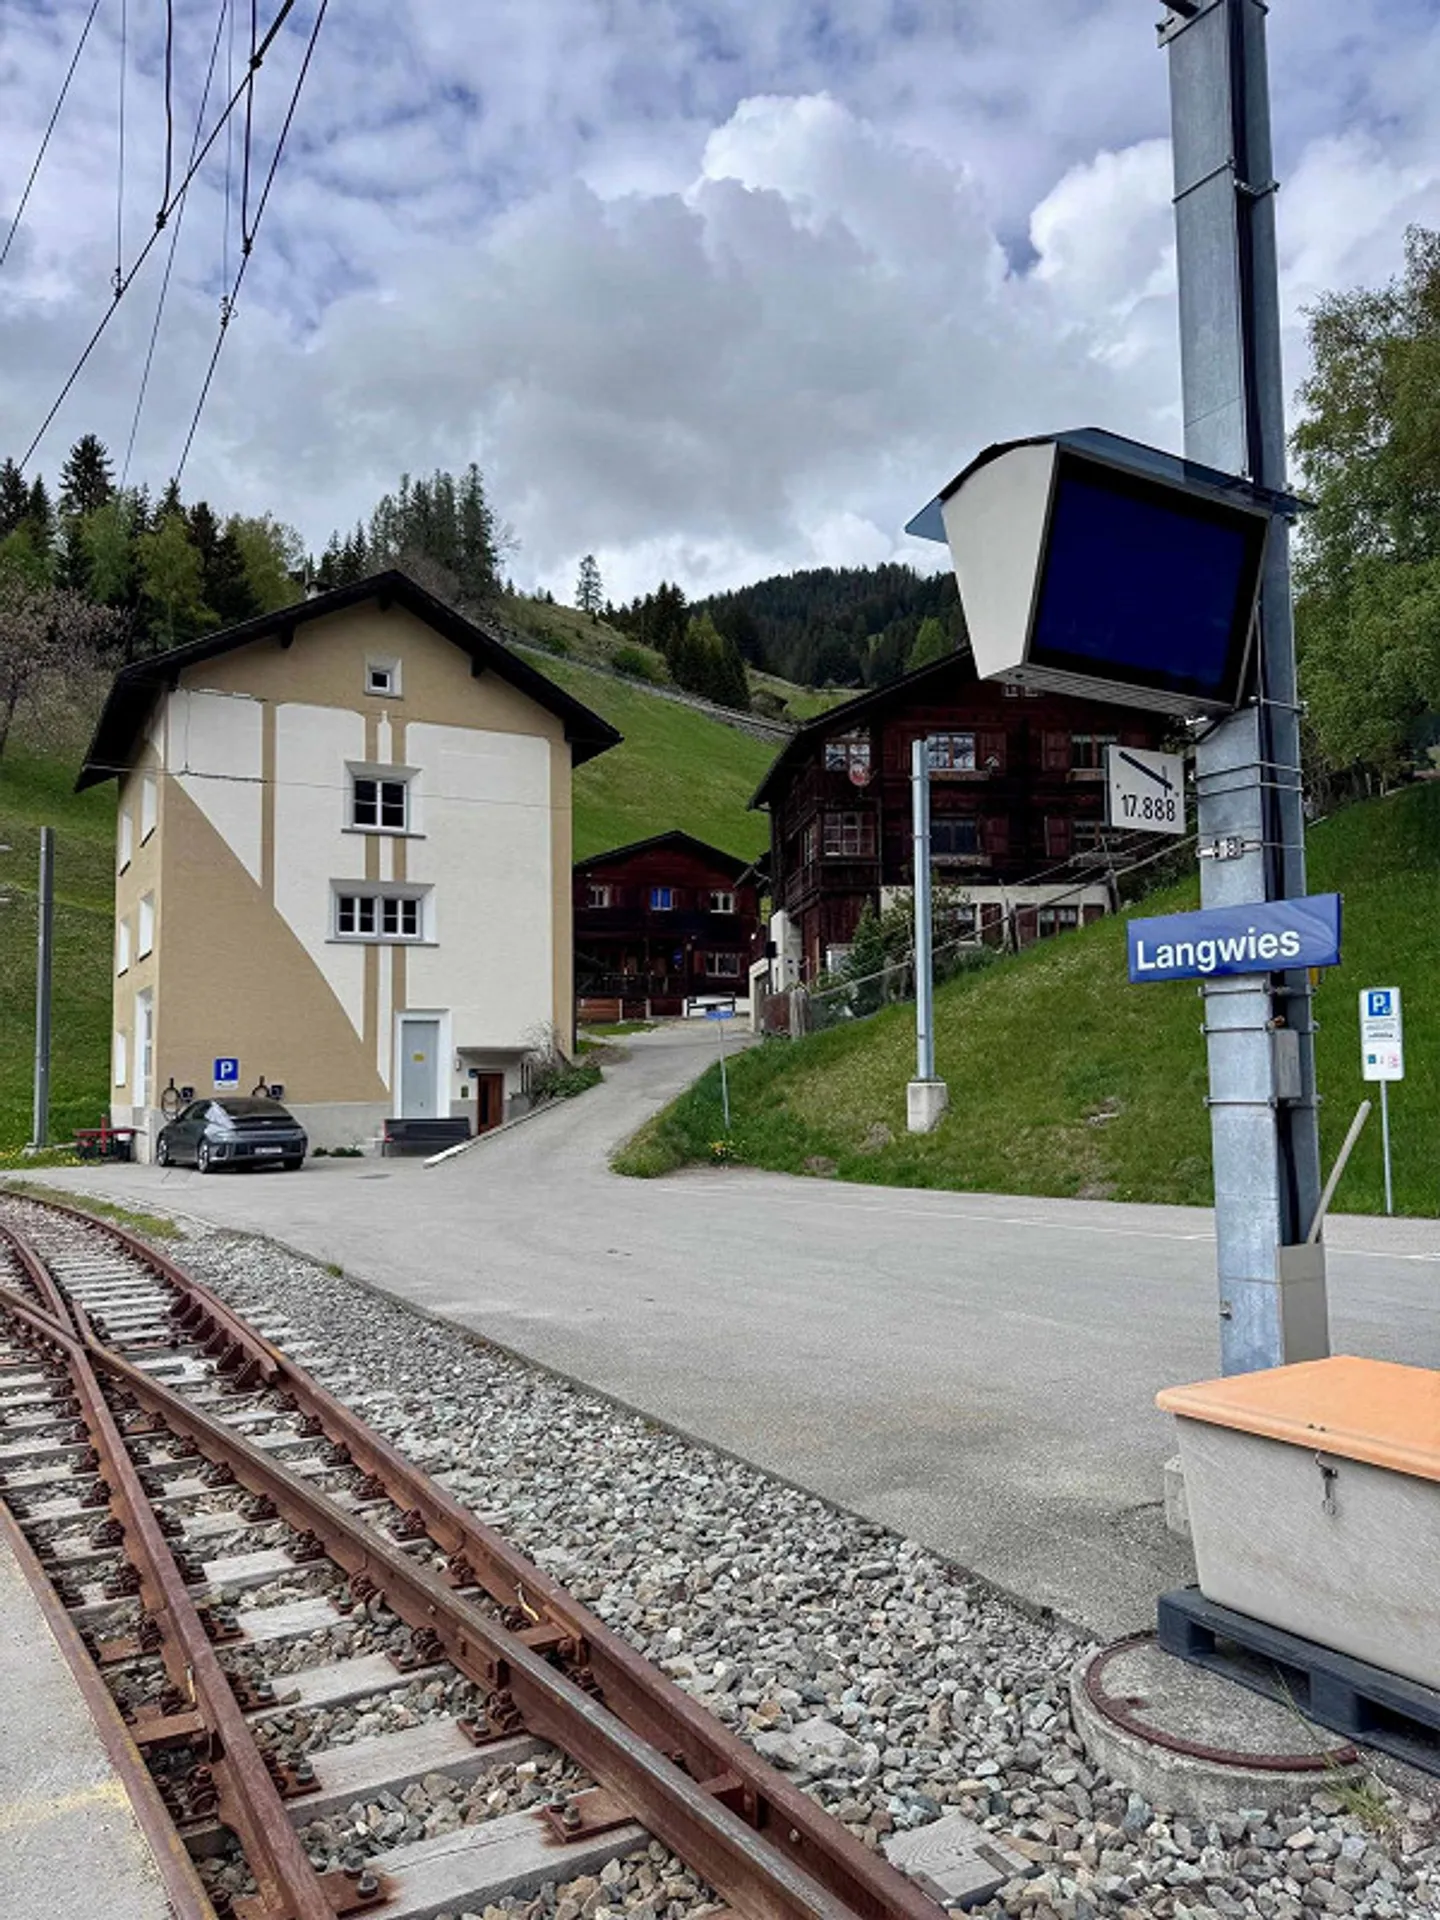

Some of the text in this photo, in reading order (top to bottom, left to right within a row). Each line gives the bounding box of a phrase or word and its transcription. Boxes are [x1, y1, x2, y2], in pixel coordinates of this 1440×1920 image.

[1121, 794, 1175, 822] 17.888
[1137, 927, 1300, 972] Langwies
[1373, 993, 1386, 1013] P
[221, 1061, 233, 1079] P
